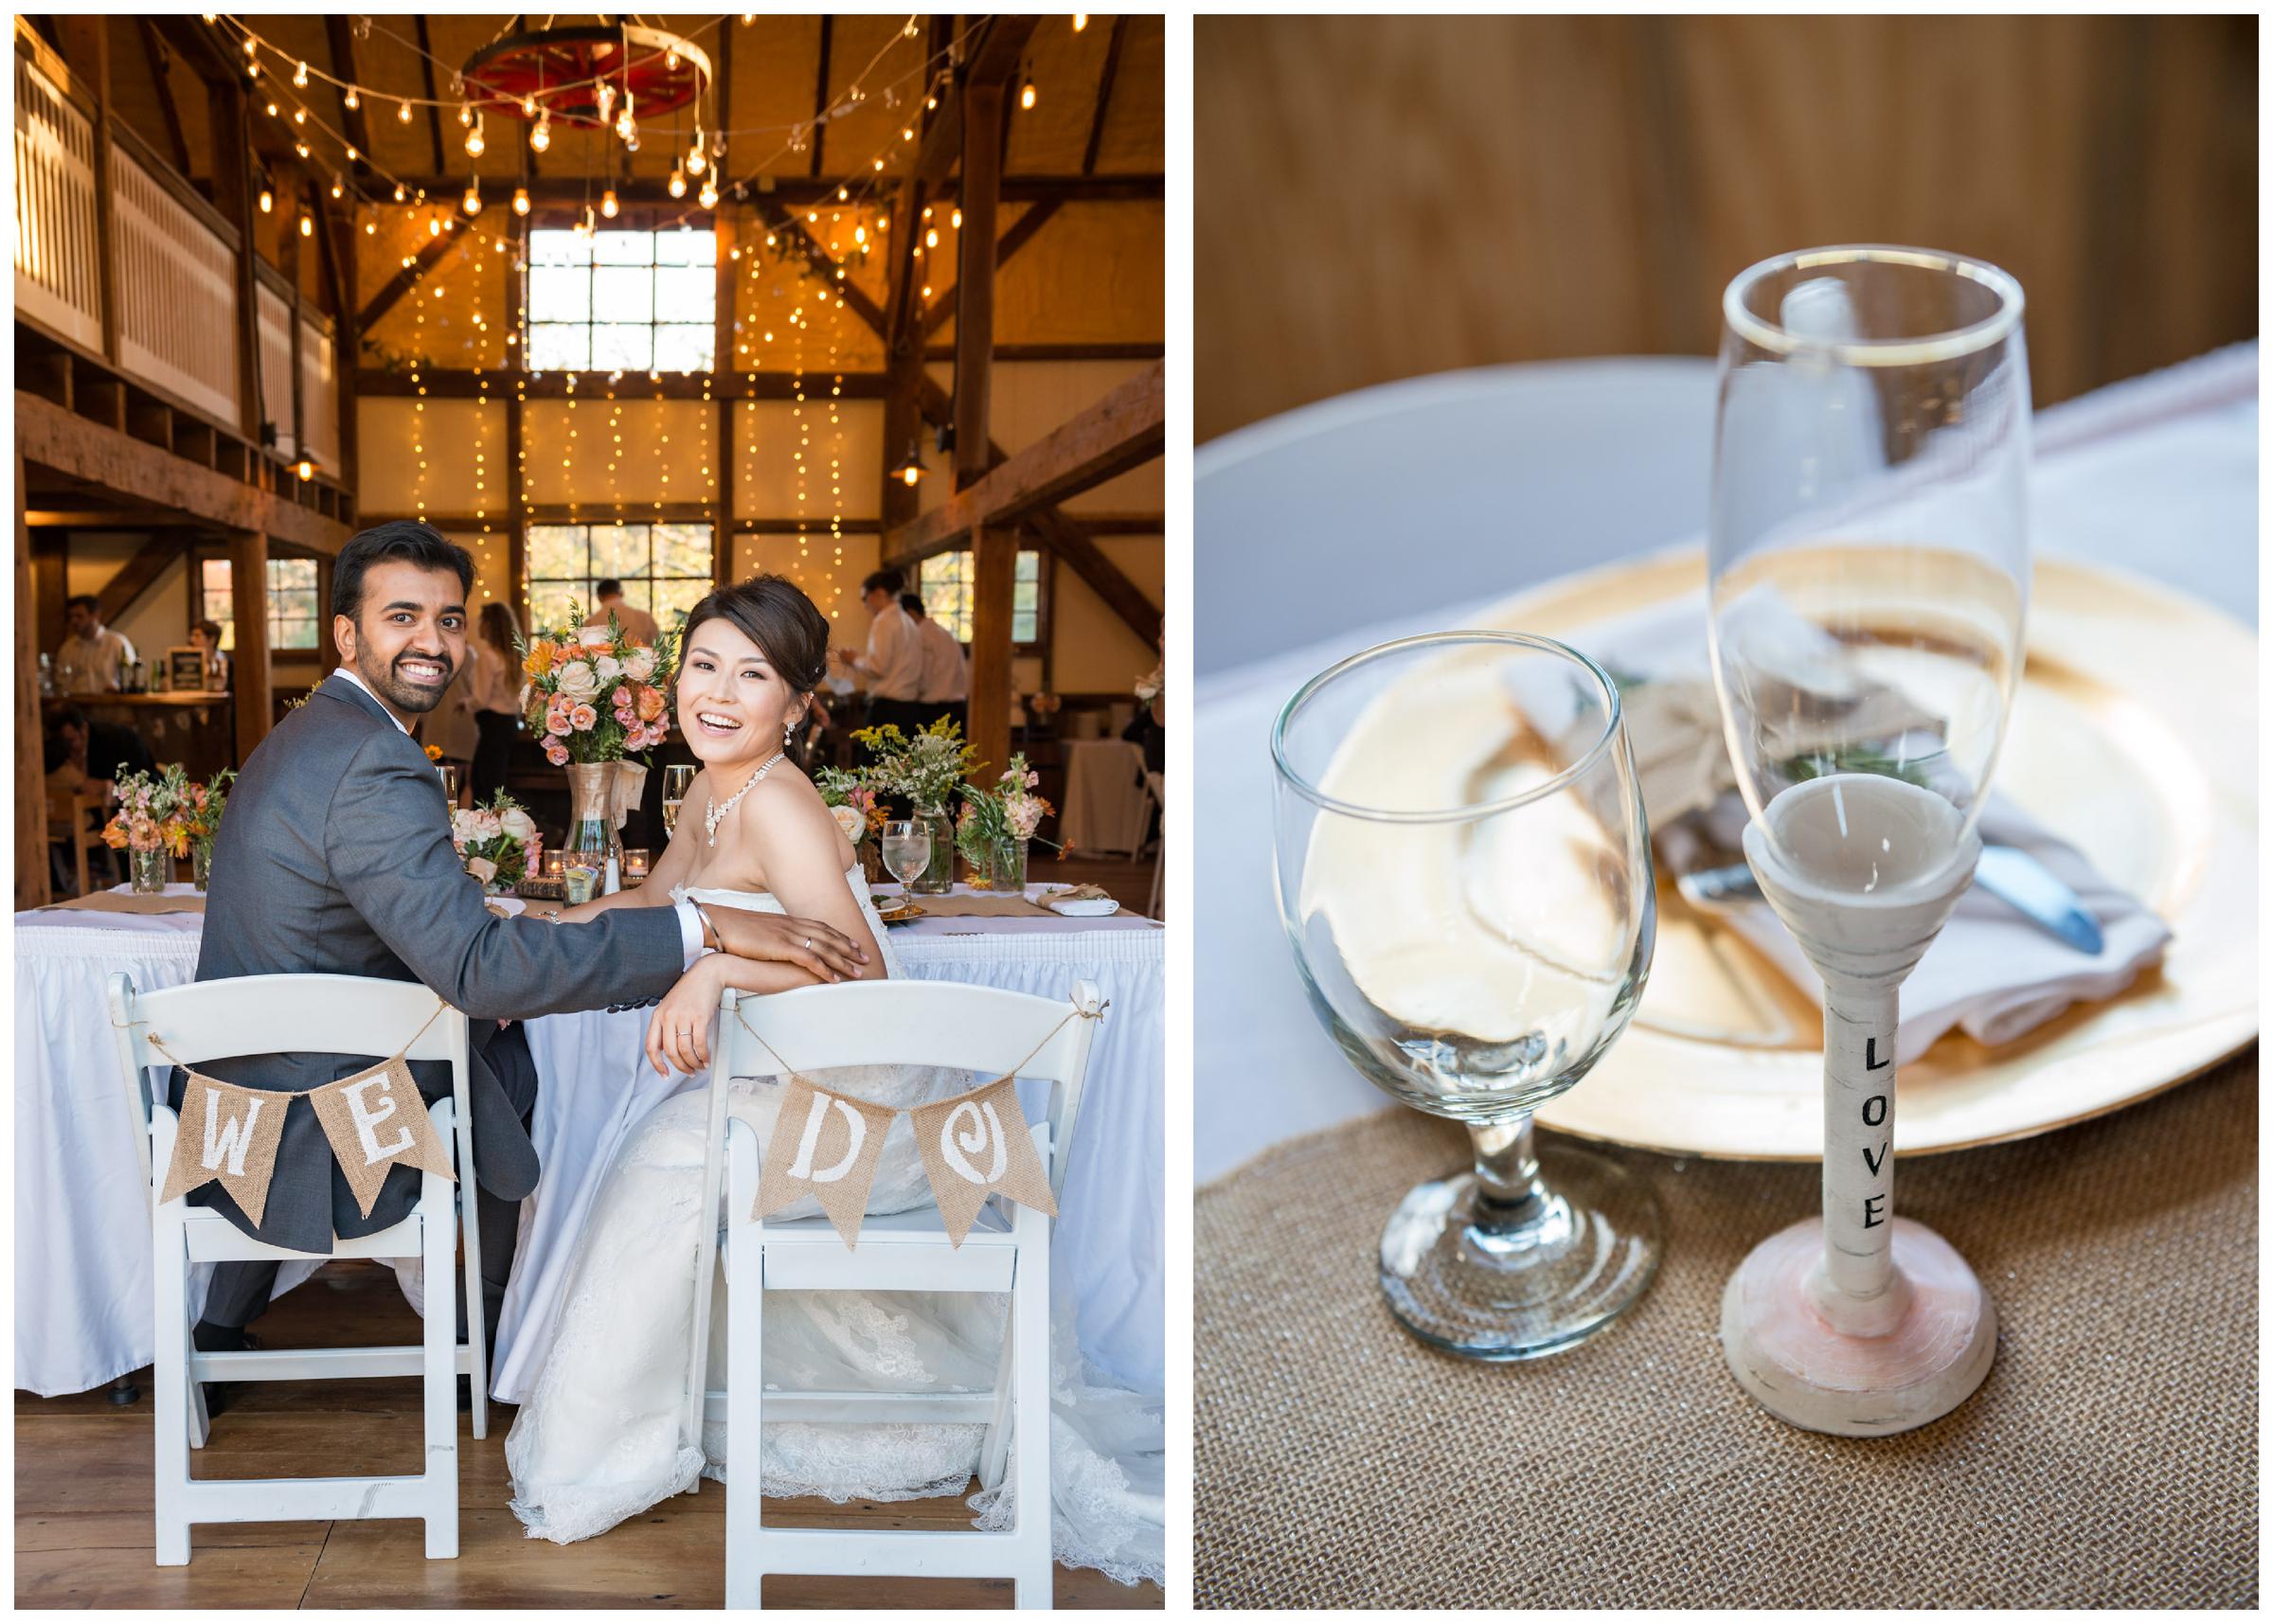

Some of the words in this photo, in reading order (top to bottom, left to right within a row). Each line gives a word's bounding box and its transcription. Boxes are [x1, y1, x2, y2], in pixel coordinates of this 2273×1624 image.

[201, 1071, 416, 1176] WE
[787, 1091, 1008, 1184] DO
[1862, 1038, 1889, 1228] LOVE
